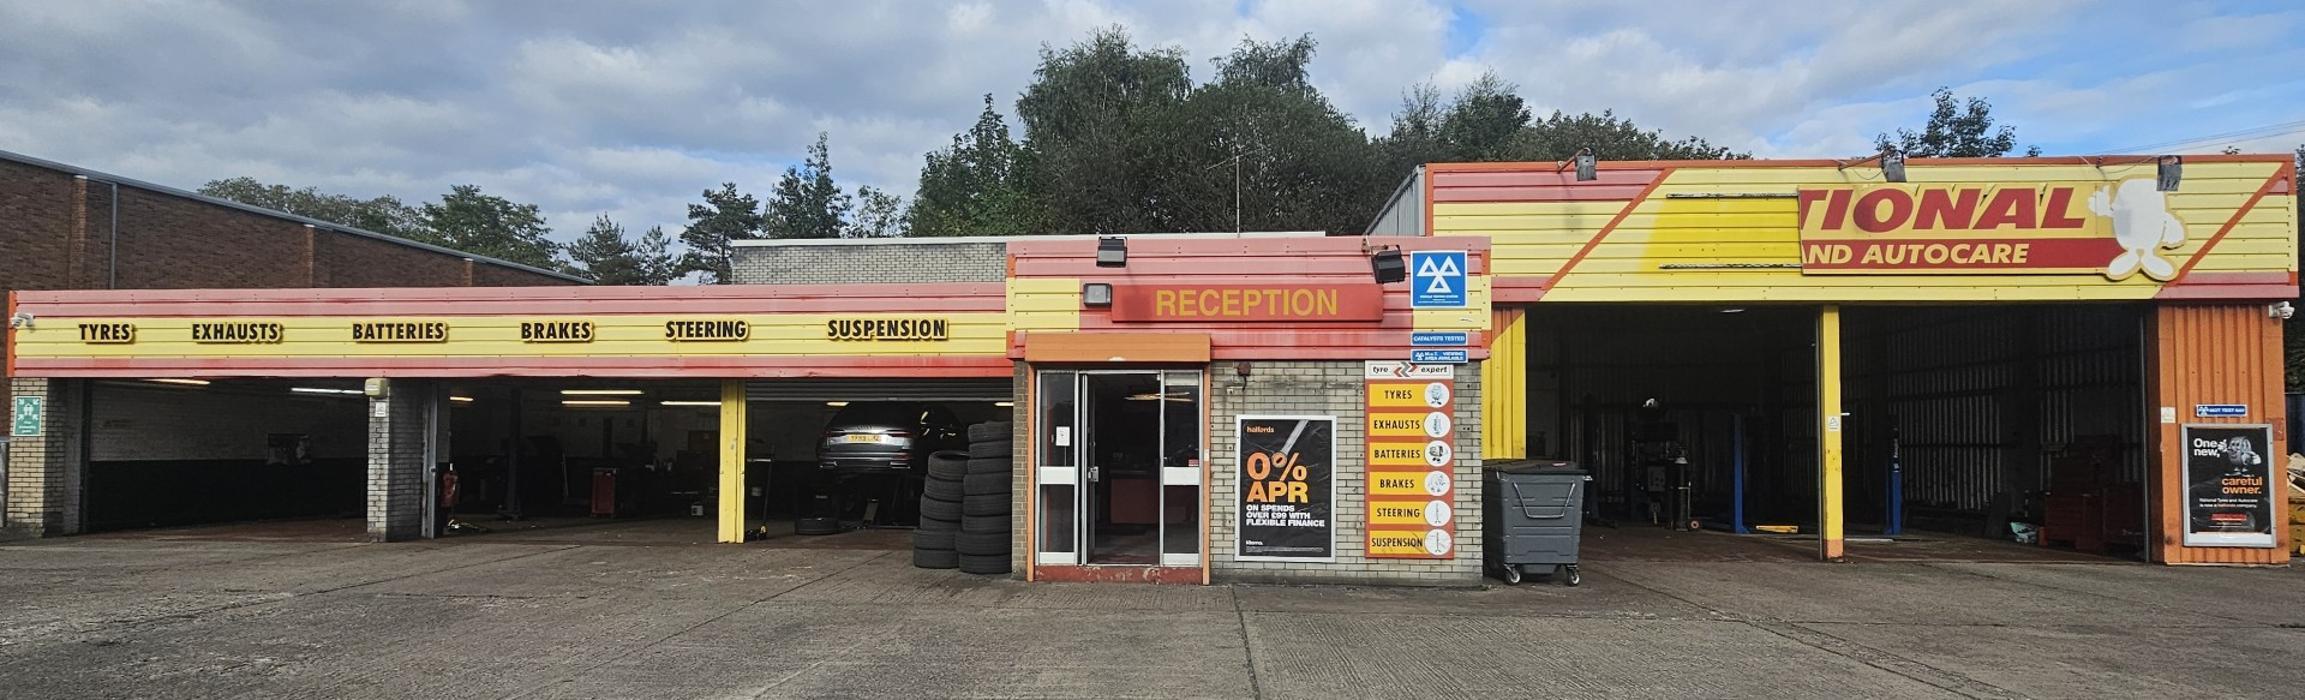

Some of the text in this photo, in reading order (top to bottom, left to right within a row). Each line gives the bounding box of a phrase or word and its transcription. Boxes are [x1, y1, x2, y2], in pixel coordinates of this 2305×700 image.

[1799, 187, 2086, 233] TIONAL
[1801, 243, 2030, 265] ND AUTOCARE
[1156, 288, 1337, 316] RECEPTION
[78, 323, 133, 341] TYRES
[192, 323, 281, 341] EXHAUSTS
[352, 322, 446, 340] BATTERIES
[520, 321, 592, 340] BRAKES
[665, 320, 748, 339] STEERING
[827, 319, 947, 338] SUSPENSION
[1372, 366, 1448, 374] tyre expert
[1384, 389, 1413, 400] TYRES
[1246, 425, 1275, 433] halfords
[1373, 419, 1421, 430] EXHAUSTS
[2193, 438, 2218, 448] One
[1374, 449, 1421, 459] BATTERIES
[2194, 448, 2220, 458] new,
[1246, 451, 1308, 481] 0%
[1379, 479, 1415, 489] BRAKES
[2221, 476, 2263, 486] careful
[1246, 481, 1309, 503] APR
[2222, 486, 2262, 495] owner.
[1260, 504, 1295, 512] SPENDS
[1376, 508, 1421, 518] STEERING
[1245, 511, 1269, 519] OVER
[1287, 519, 1325, 527] FINANCE
[1371, 537, 1423, 548] SUSPENSION
